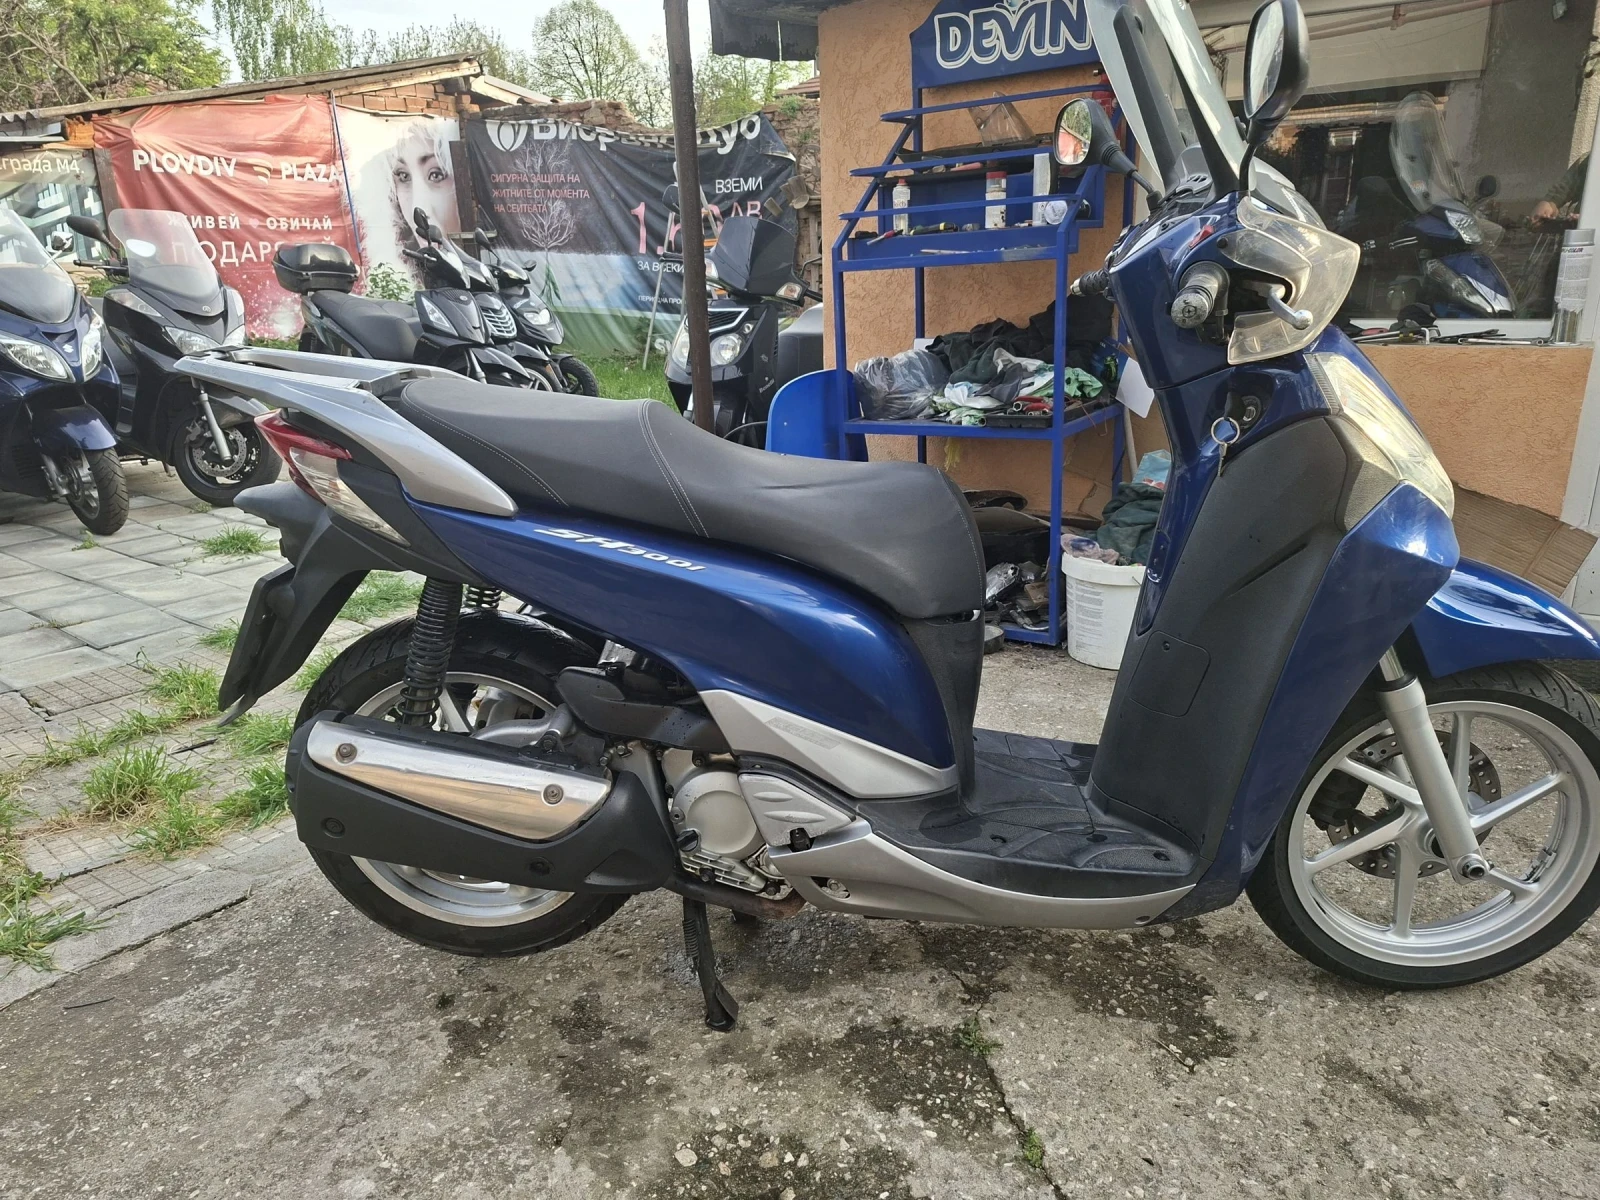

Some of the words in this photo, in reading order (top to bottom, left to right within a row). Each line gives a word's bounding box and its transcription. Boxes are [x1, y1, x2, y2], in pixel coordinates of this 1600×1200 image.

[935, 0, 1092, 69] DEVIN
[0, 157, 53, 175] града
[132, 149, 237, 178] PLOVDIV
[280, 161, 342, 183] PLAZA
[491, 173, 528, 183] СИГУРНА
[530, 173, 565, 184] ЗАЩИТА
[567, 174, 581, 183] НА
[715, 176, 763, 194] ВЗЕМИ
[534, 189, 544, 198] ОТ
[546, 189, 590, 199] МОМЕНТА
[265, 215, 333, 231] ОБИЧАЙ
[637, 260, 650, 270] ЗА
